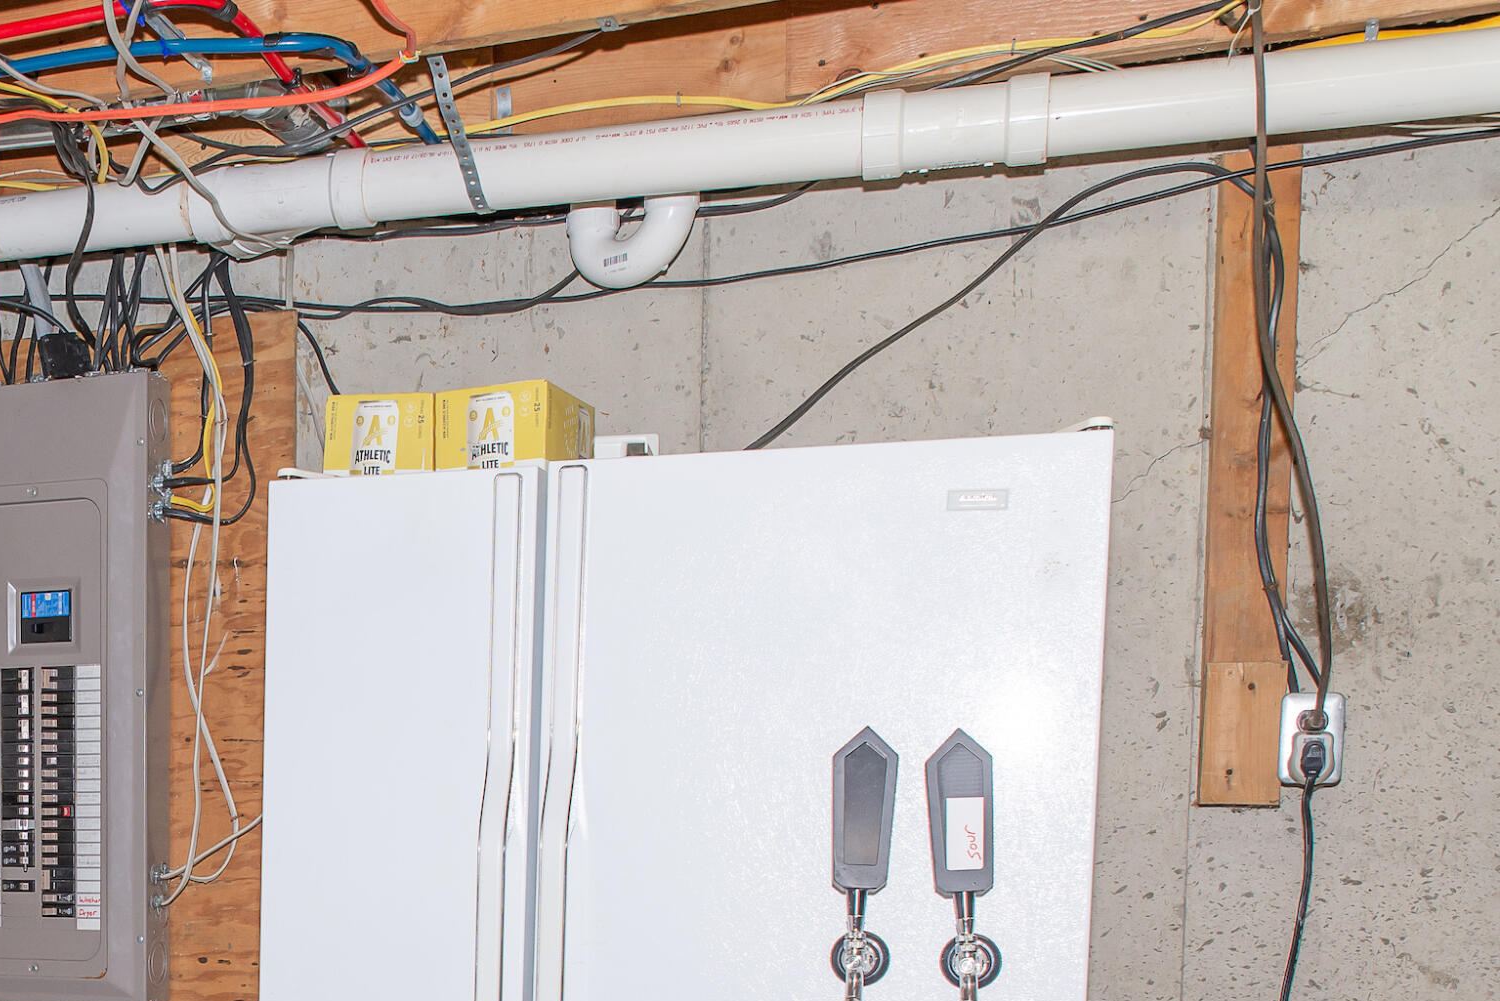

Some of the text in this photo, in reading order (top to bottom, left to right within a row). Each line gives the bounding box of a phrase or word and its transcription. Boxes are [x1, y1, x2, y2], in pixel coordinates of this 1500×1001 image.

[472, 441, 509, 460] ATHLETIC
[355, 449, 391, 465] ATHLETIC
[482, 459, 499, 470] LITE
[363, 465, 381, 476] LITE
[79, 908, 97, 919] Dryer
